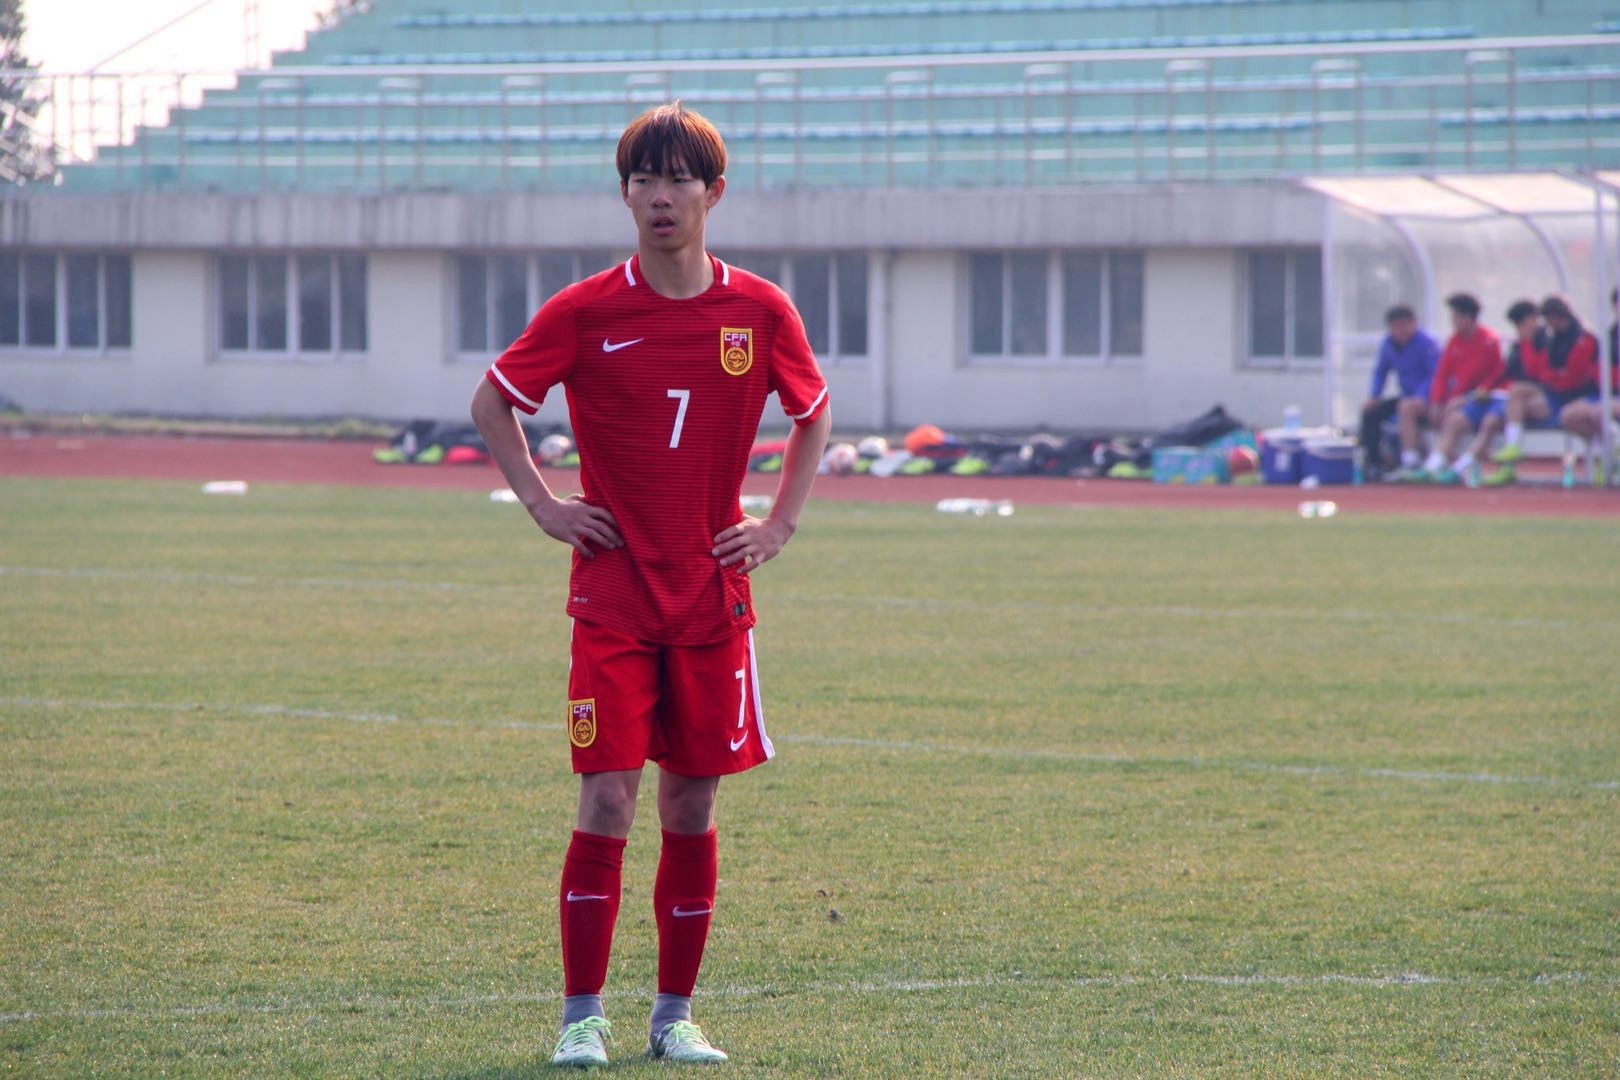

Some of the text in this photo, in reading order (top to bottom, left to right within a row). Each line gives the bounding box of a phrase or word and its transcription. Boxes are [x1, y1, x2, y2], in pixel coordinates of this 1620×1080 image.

[724, 332, 748, 342] CFA
[667, 389, 690, 448] 7
[573, 703, 592, 714] CFA
[735, 668, 746, 728] 7
